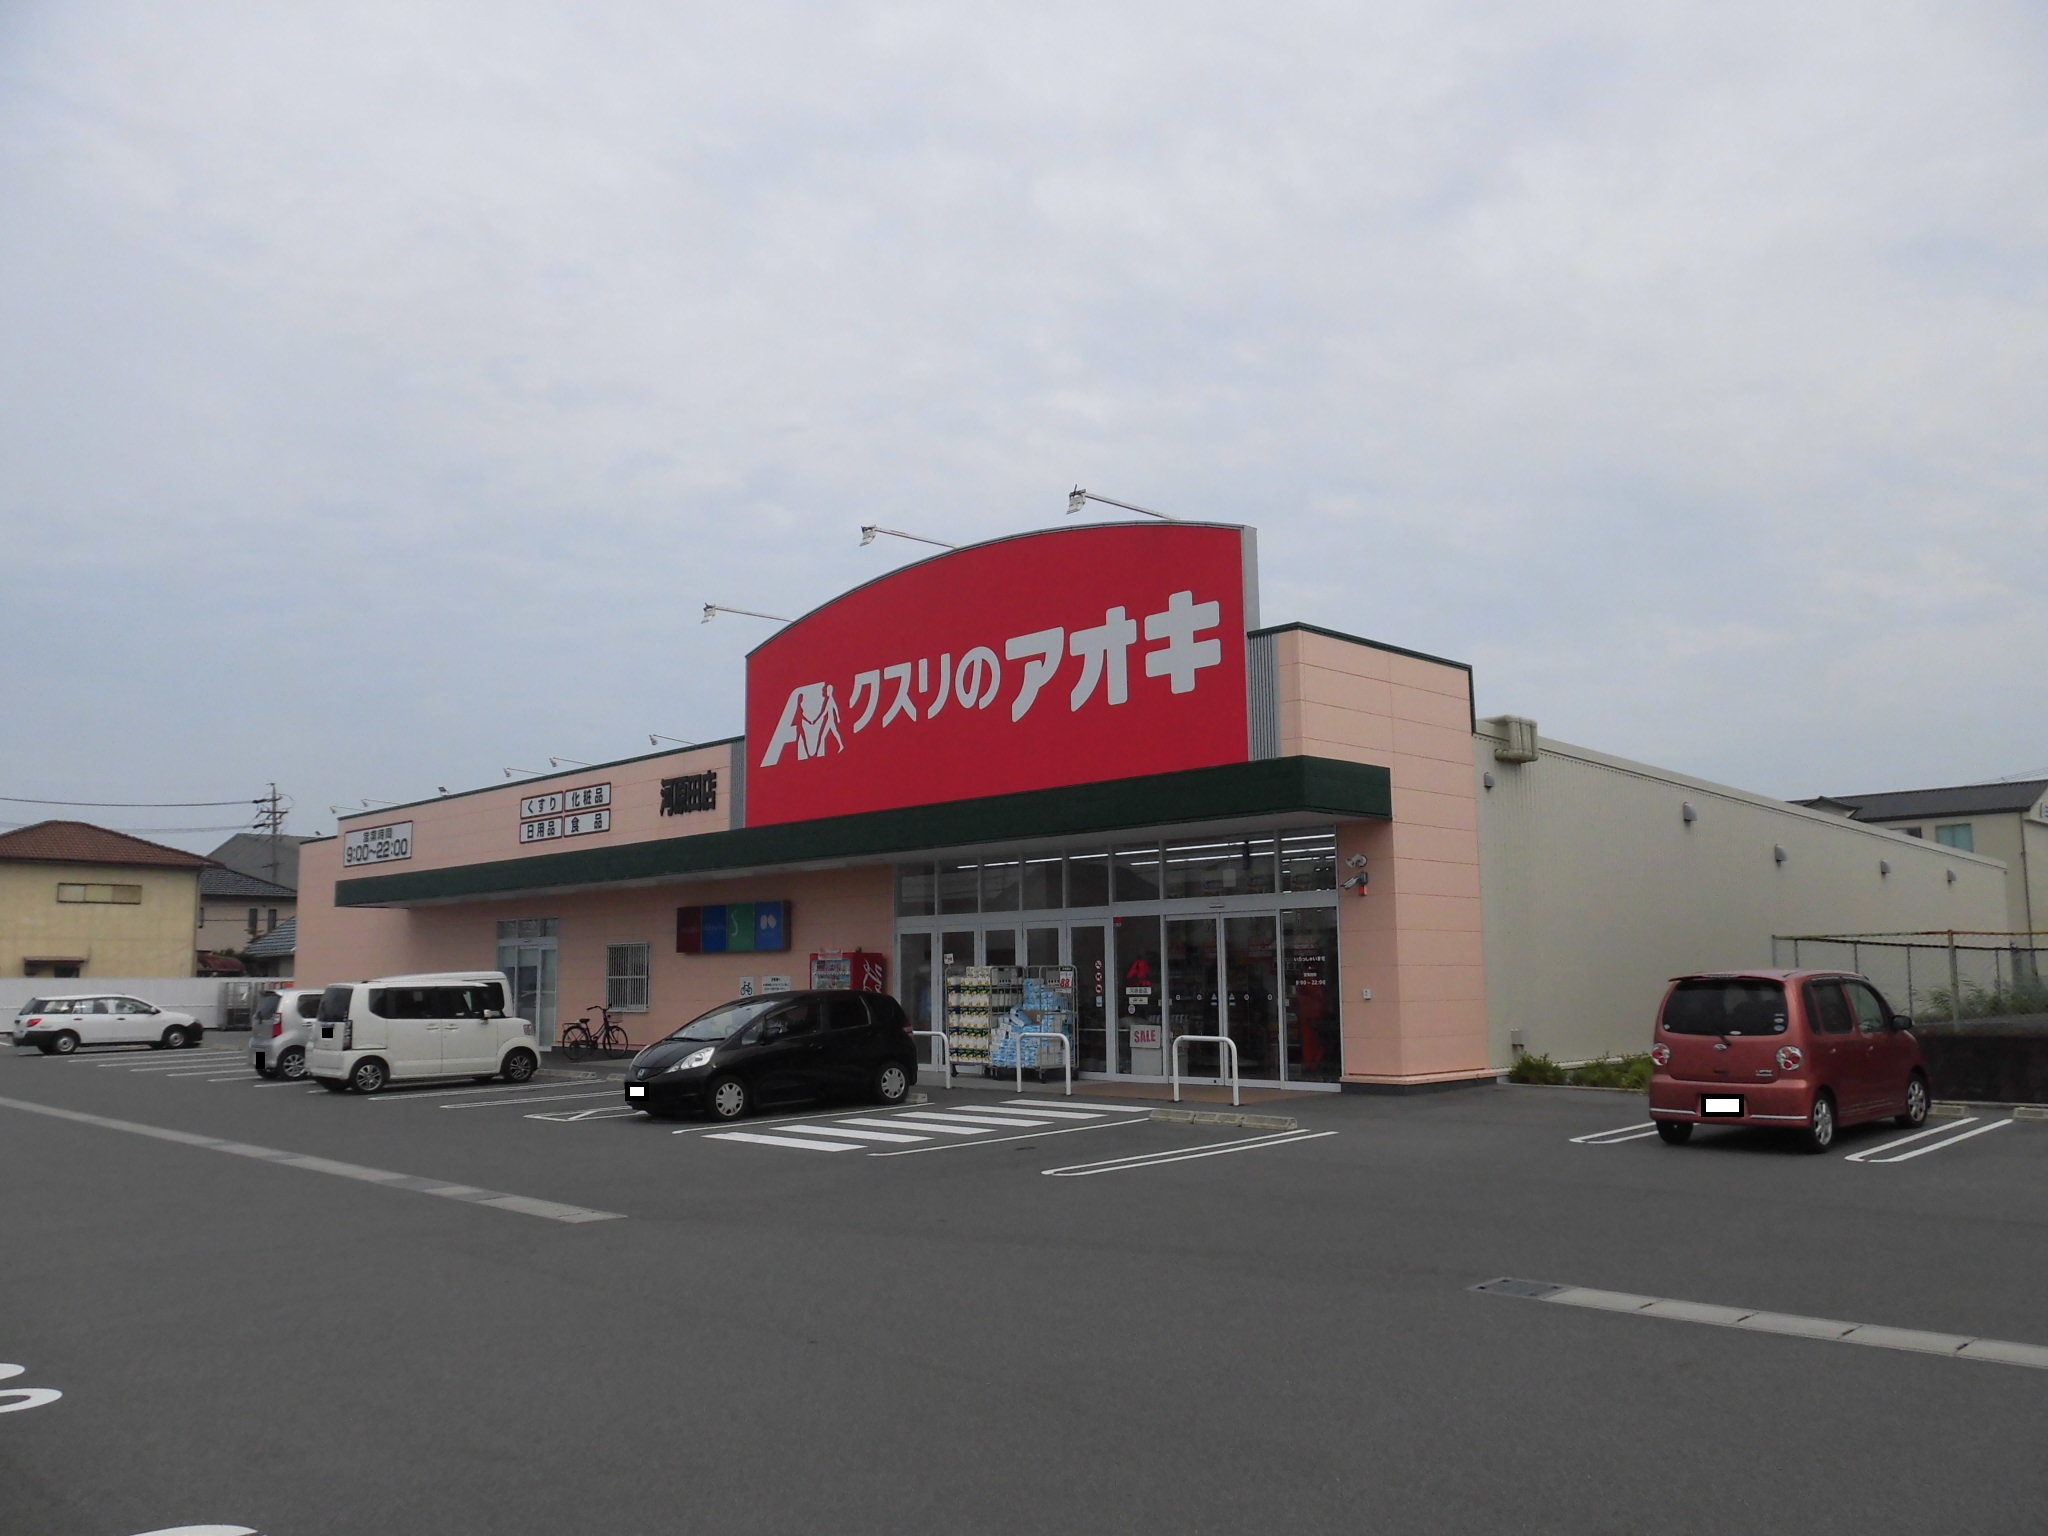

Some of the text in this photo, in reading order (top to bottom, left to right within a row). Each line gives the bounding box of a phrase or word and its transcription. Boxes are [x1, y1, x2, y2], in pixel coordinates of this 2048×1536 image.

[849, 590, 1222, 734] クスリのアオキ
[571, 787, 604, 808] 化粧品
[660, 769, 717, 817] 河原田店
[527, 797, 557, 814] くすり
[526, 821, 556, 839] 日用品
[571, 813, 603, 833] 食品
[346, 838, 408, 863] 9:00~22:00
[1134, 1029, 1156, 1043] SALE
